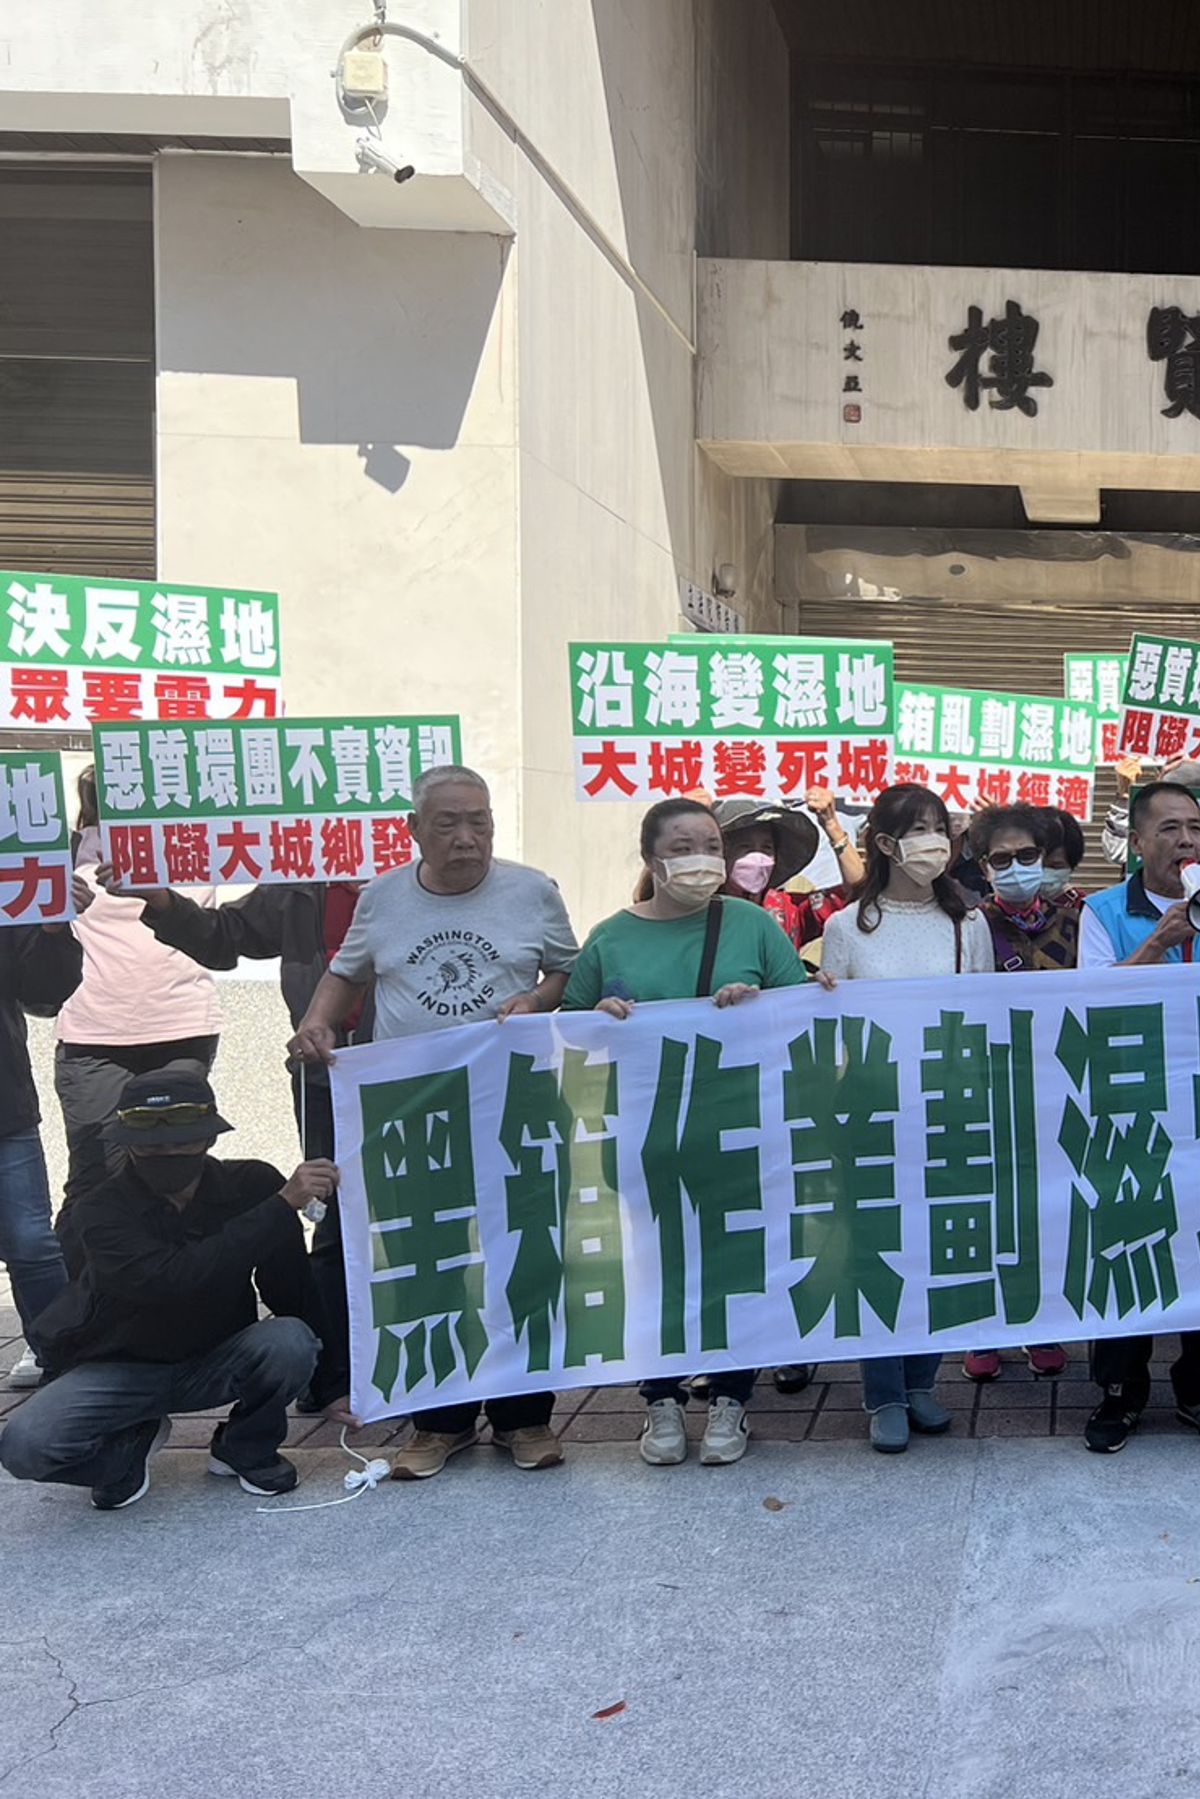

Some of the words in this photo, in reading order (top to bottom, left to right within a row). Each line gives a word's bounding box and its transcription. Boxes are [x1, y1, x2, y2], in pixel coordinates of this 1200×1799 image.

[6, 581, 278, 669] 決反濕地
[576, 650, 888, 729] 沿海變濕地
[582, 739, 890, 797] 大城變死城
[406, 930, 501, 966] WASHINGTON
[417, 984, 496, 1016] INDIANS
